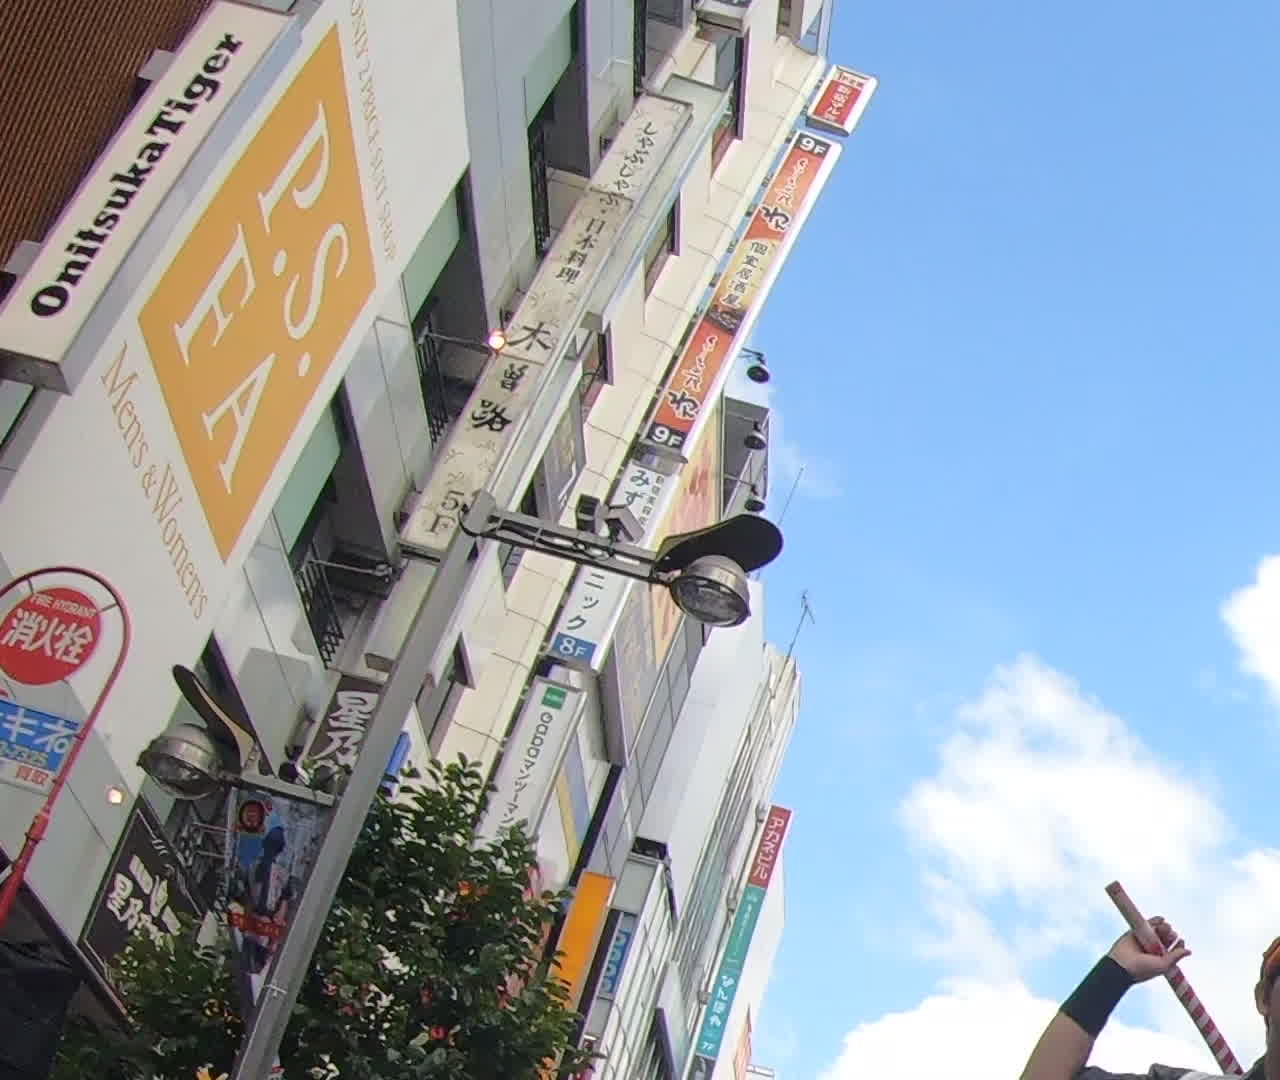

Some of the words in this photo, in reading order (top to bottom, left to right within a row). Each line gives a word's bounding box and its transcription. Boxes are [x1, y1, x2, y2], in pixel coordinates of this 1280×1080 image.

[799, 137, 830, 157] 9F
[652, 426, 683, 448] 9F
[1, 606, 94, 665] 消火栓
[558, 637, 587, 658] 8F
